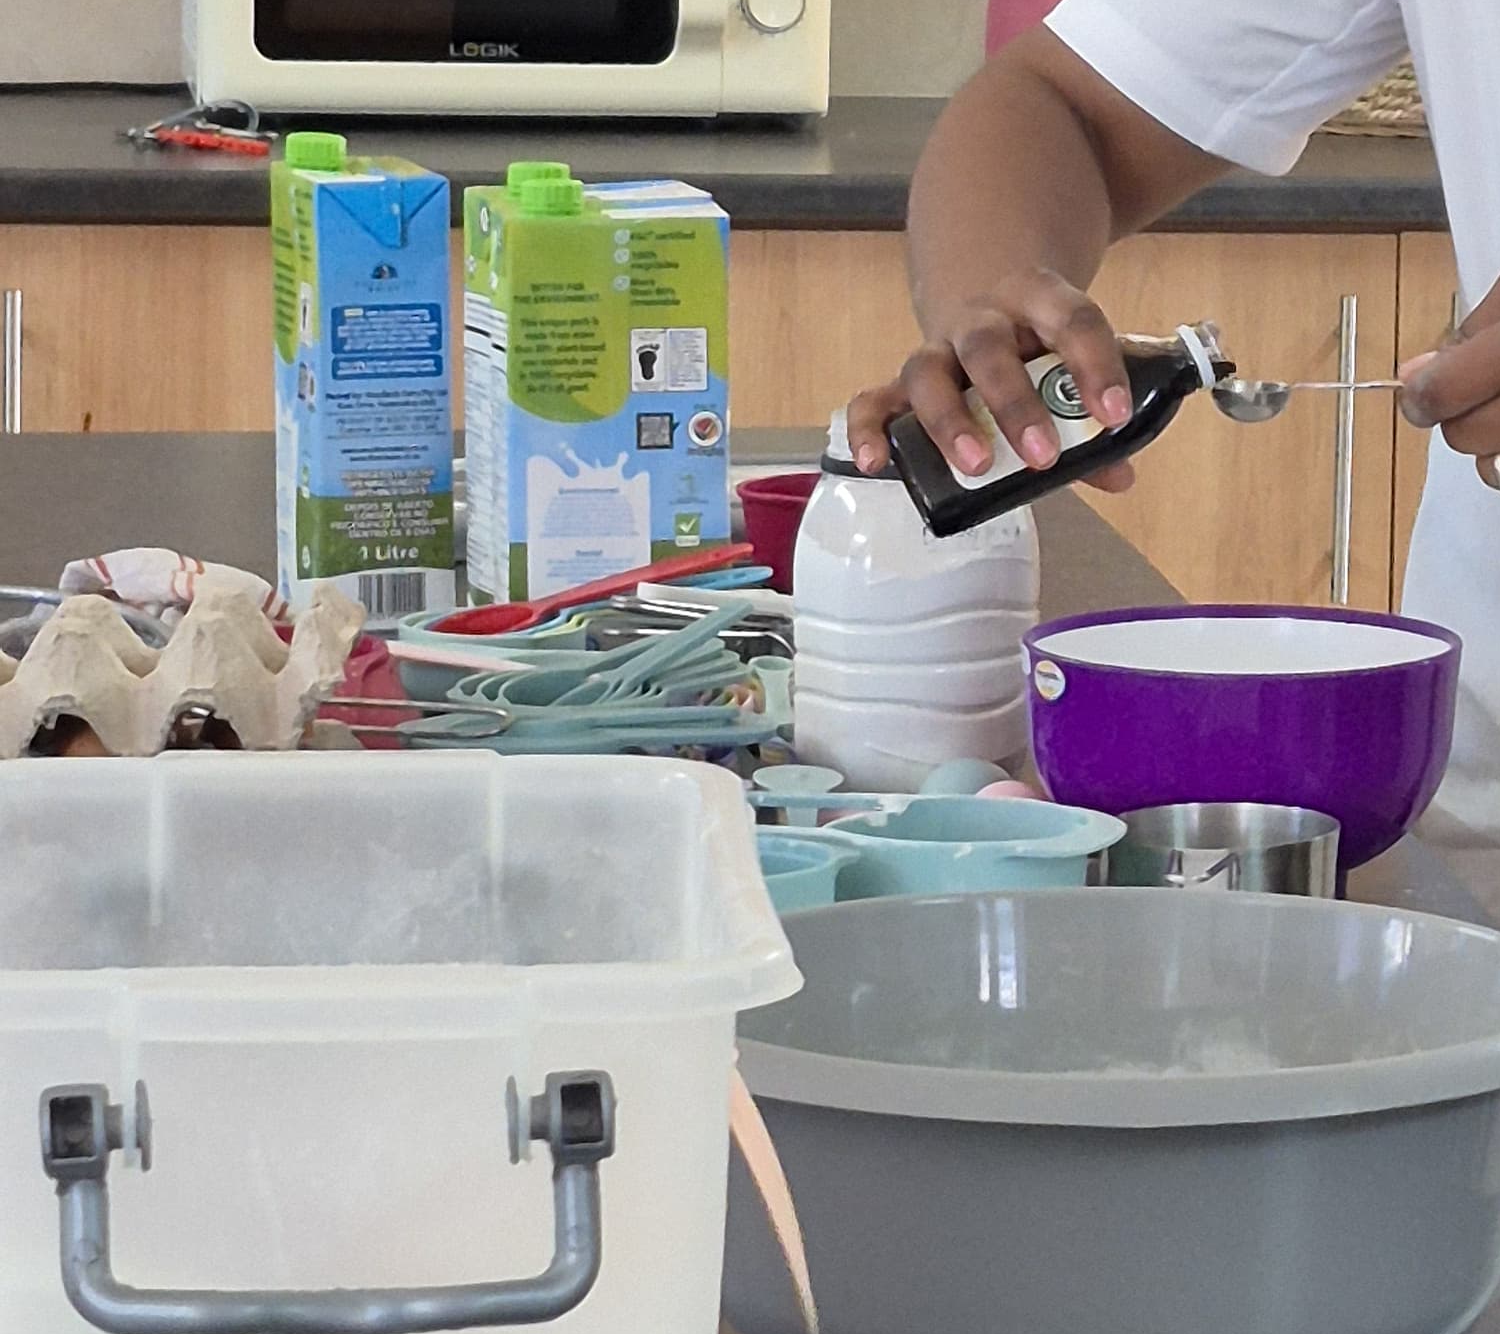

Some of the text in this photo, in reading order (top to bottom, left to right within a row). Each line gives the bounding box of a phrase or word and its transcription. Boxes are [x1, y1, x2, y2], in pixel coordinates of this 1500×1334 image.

[449, 42, 519, 58] LOGIK
[360, 543, 419, 561] 1 Litre
